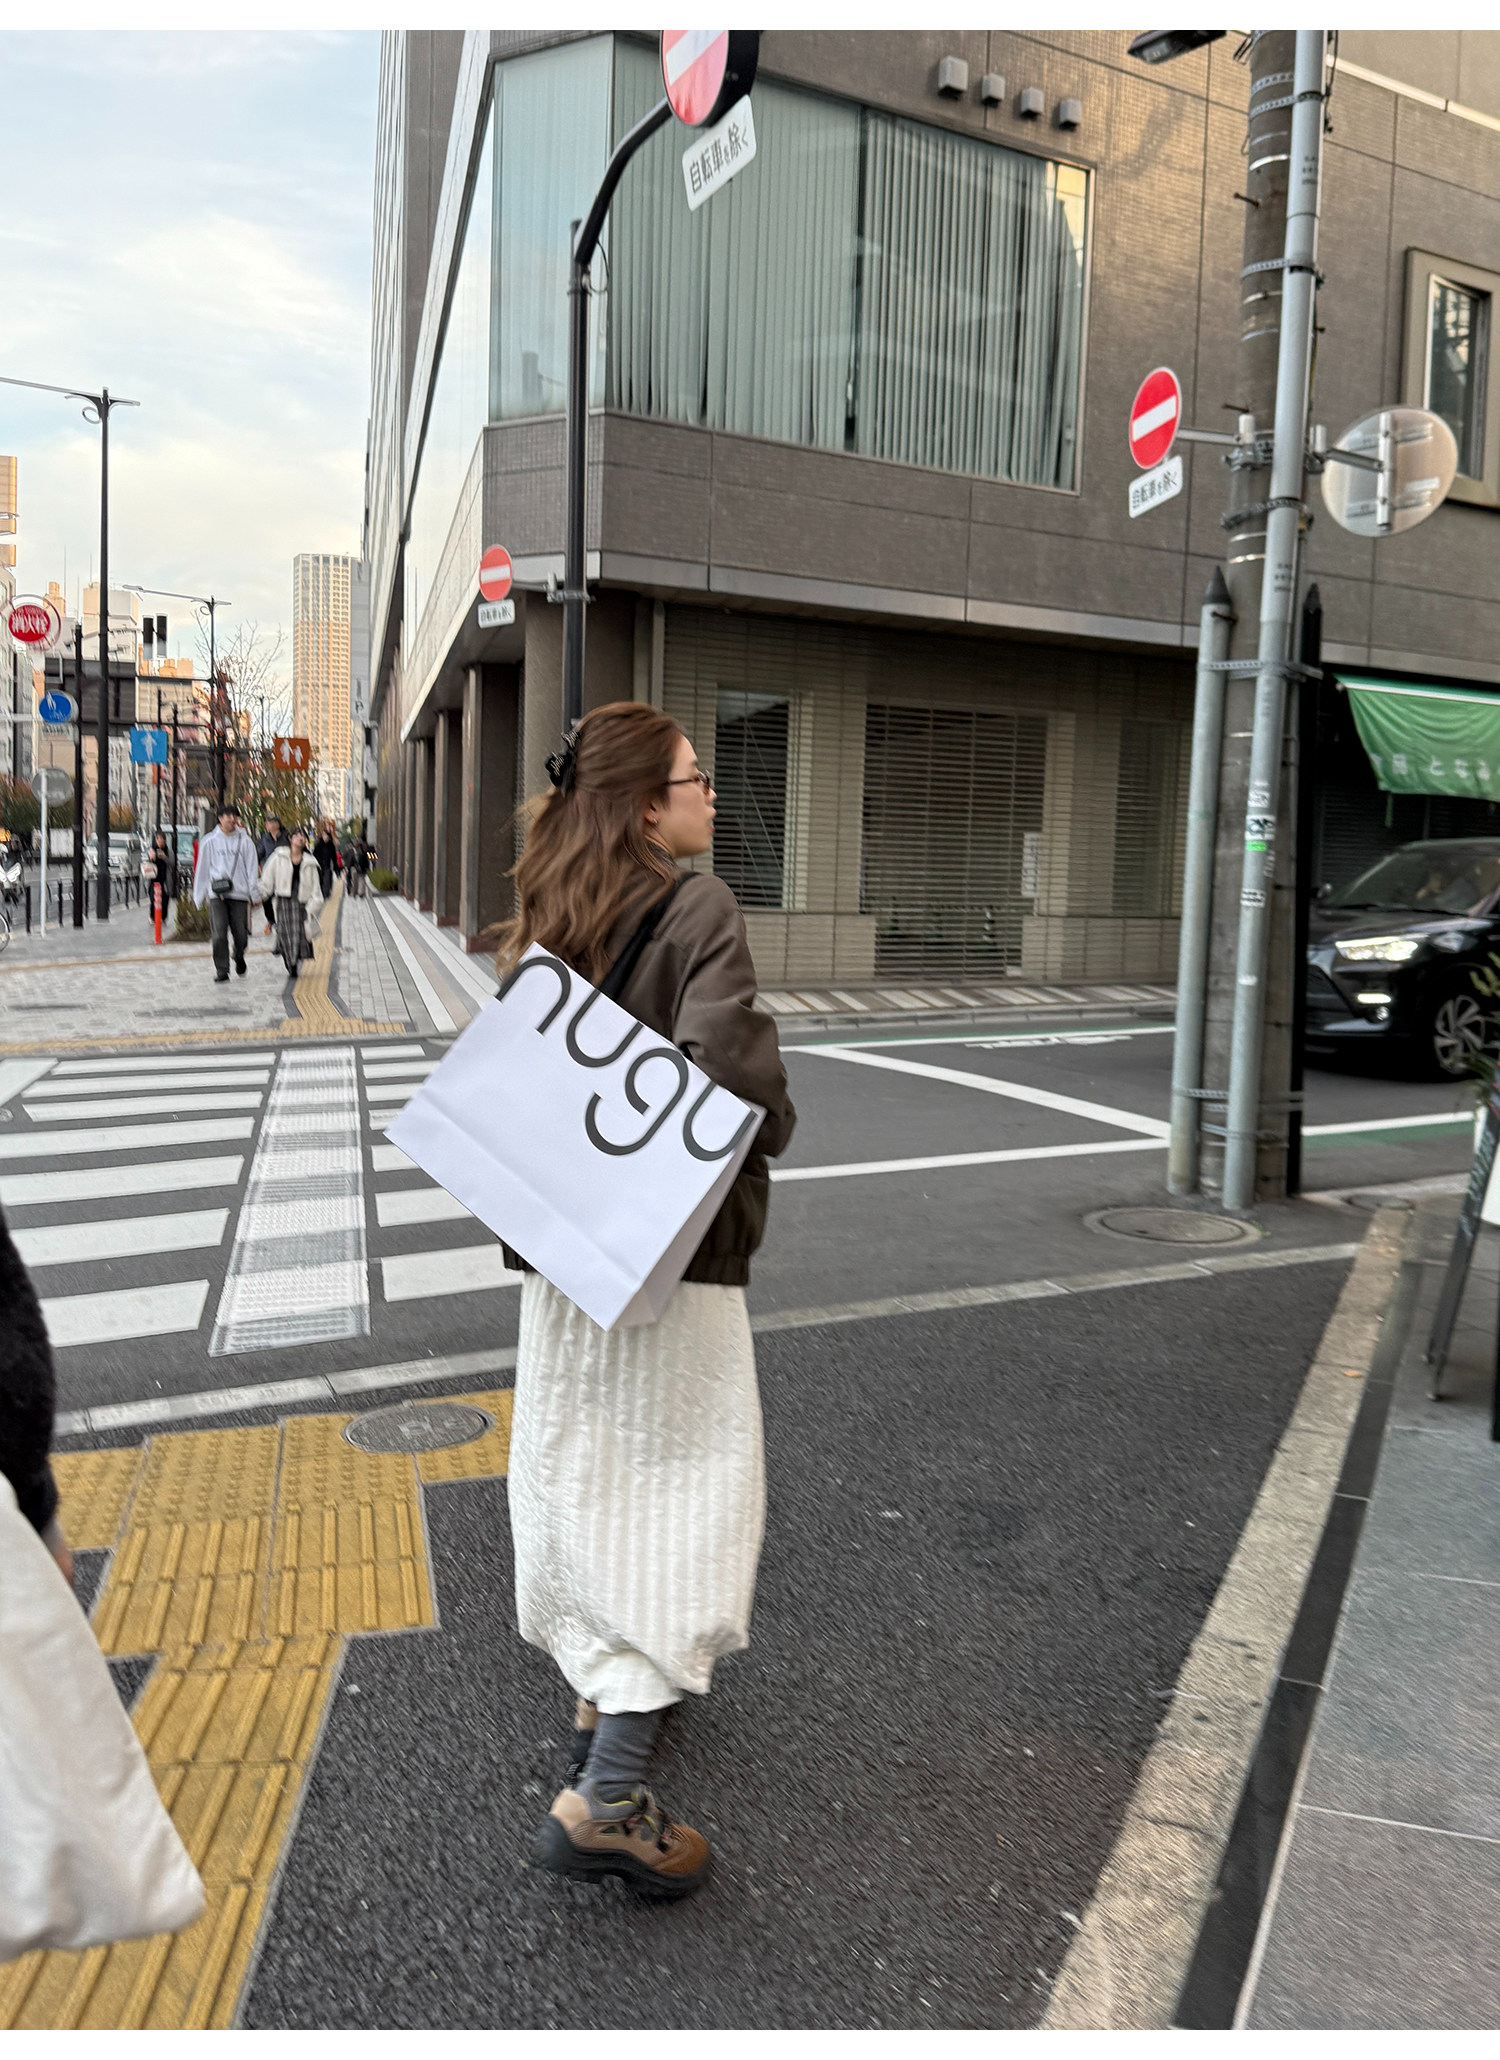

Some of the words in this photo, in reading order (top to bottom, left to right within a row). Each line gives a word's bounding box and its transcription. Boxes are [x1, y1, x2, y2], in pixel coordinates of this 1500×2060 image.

[689, 122, 749, 196] 自転車を除く
[497, 956, 758, 1161] nugu
